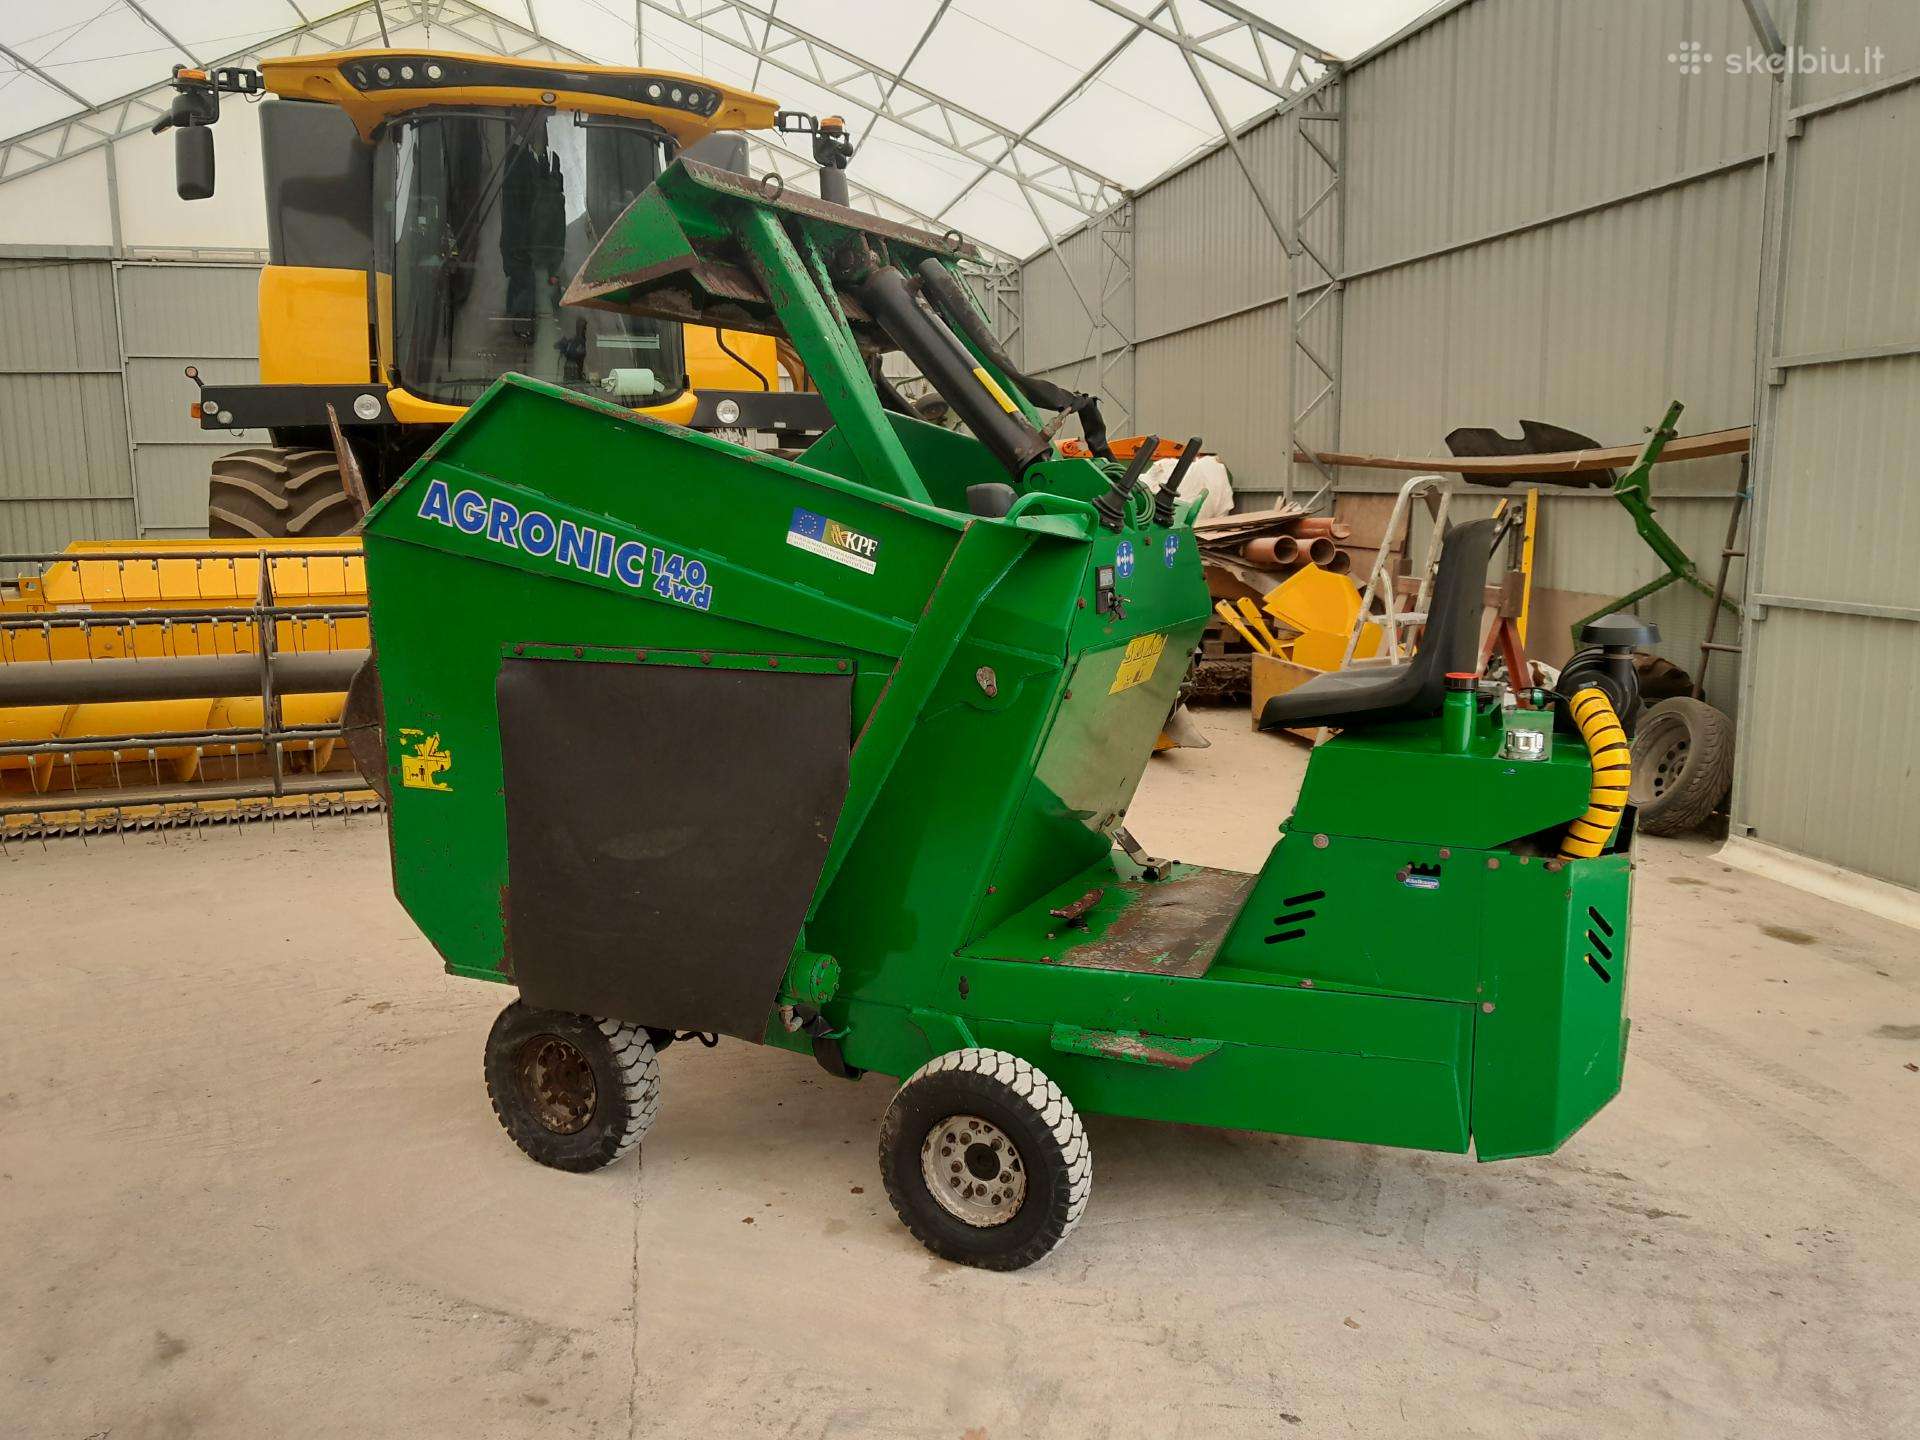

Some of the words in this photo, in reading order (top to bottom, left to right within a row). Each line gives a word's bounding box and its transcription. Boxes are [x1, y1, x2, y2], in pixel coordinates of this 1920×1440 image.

[417, 479, 647, 587] AGRONIC
[651, 548, 707, 588] 140
[845, 531, 878, 557] KPF
[653, 573, 713, 611] 4wd
